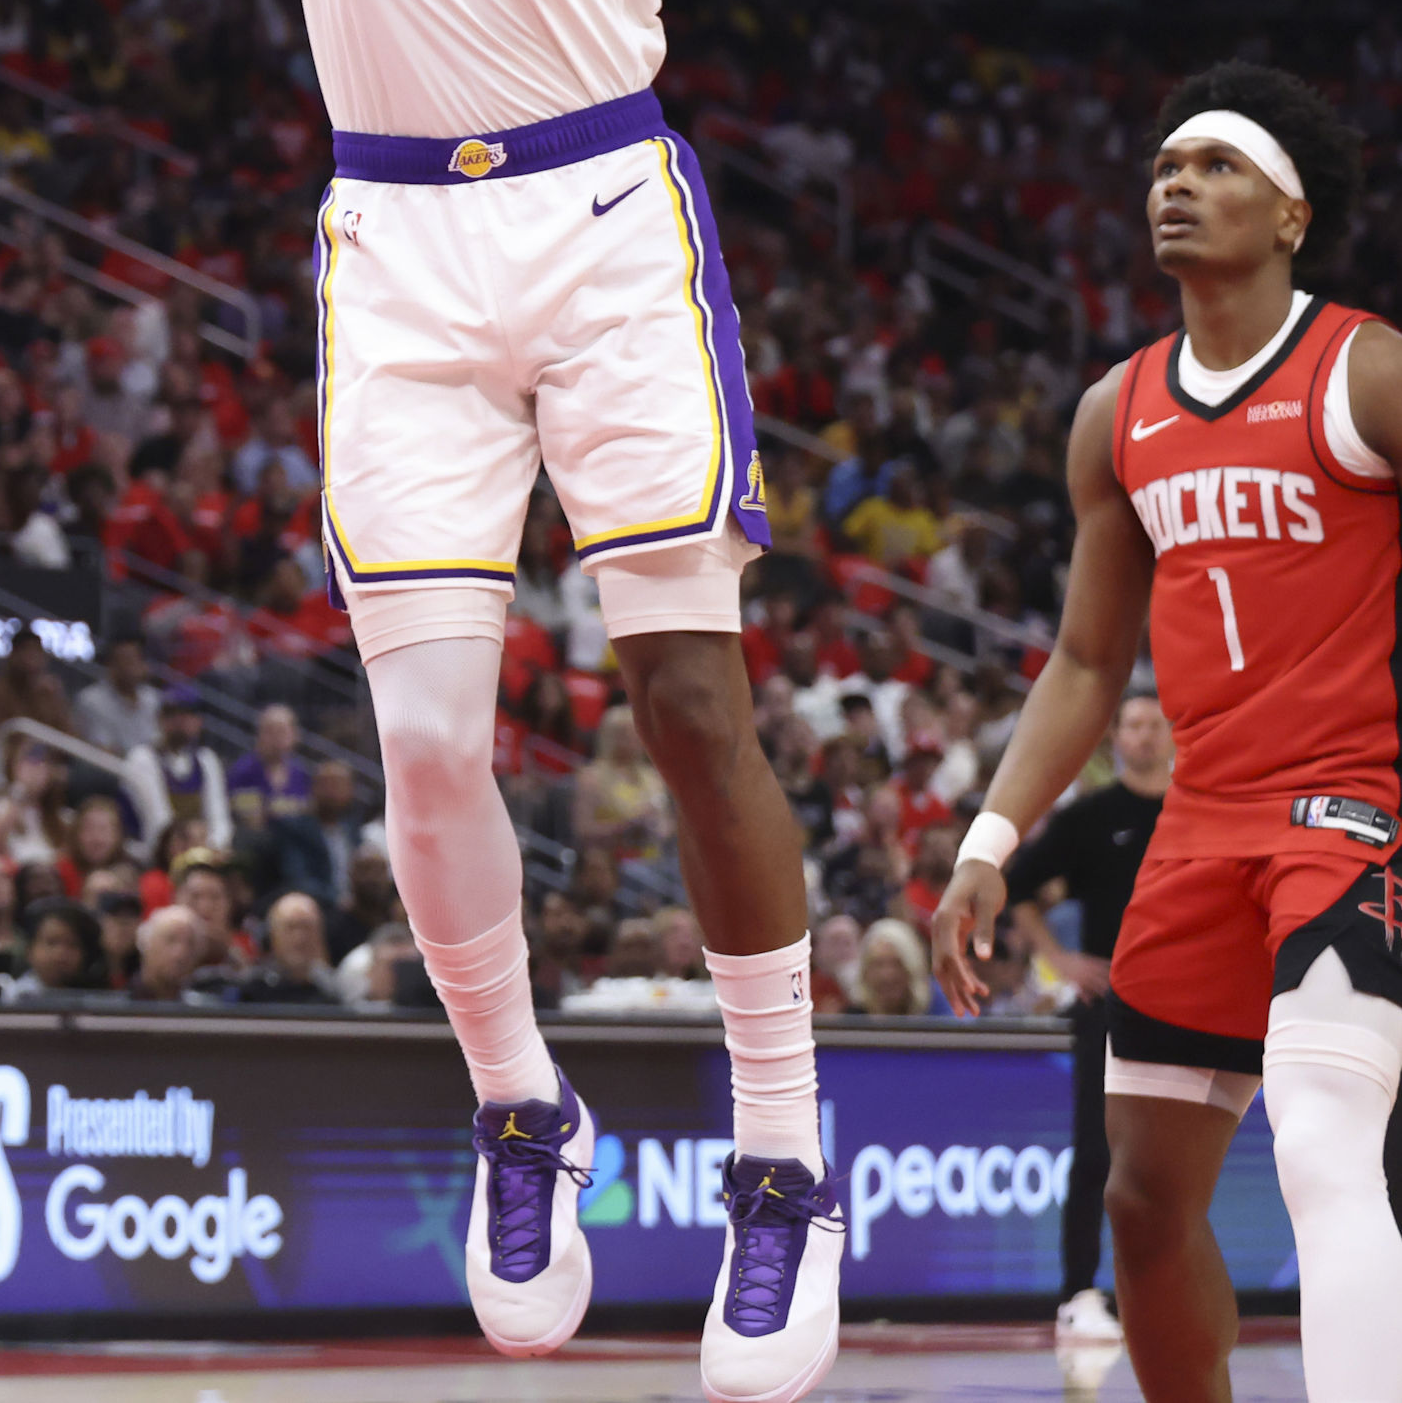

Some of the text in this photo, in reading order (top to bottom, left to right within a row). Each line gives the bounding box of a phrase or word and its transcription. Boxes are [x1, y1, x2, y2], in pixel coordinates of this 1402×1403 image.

[453, 150, 505, 169] LAKERS
[1206, 566, 1246, 672] 1
[47, 1084, 215, 1168] Presented by
[45, 1164, 284, 1284] Google
